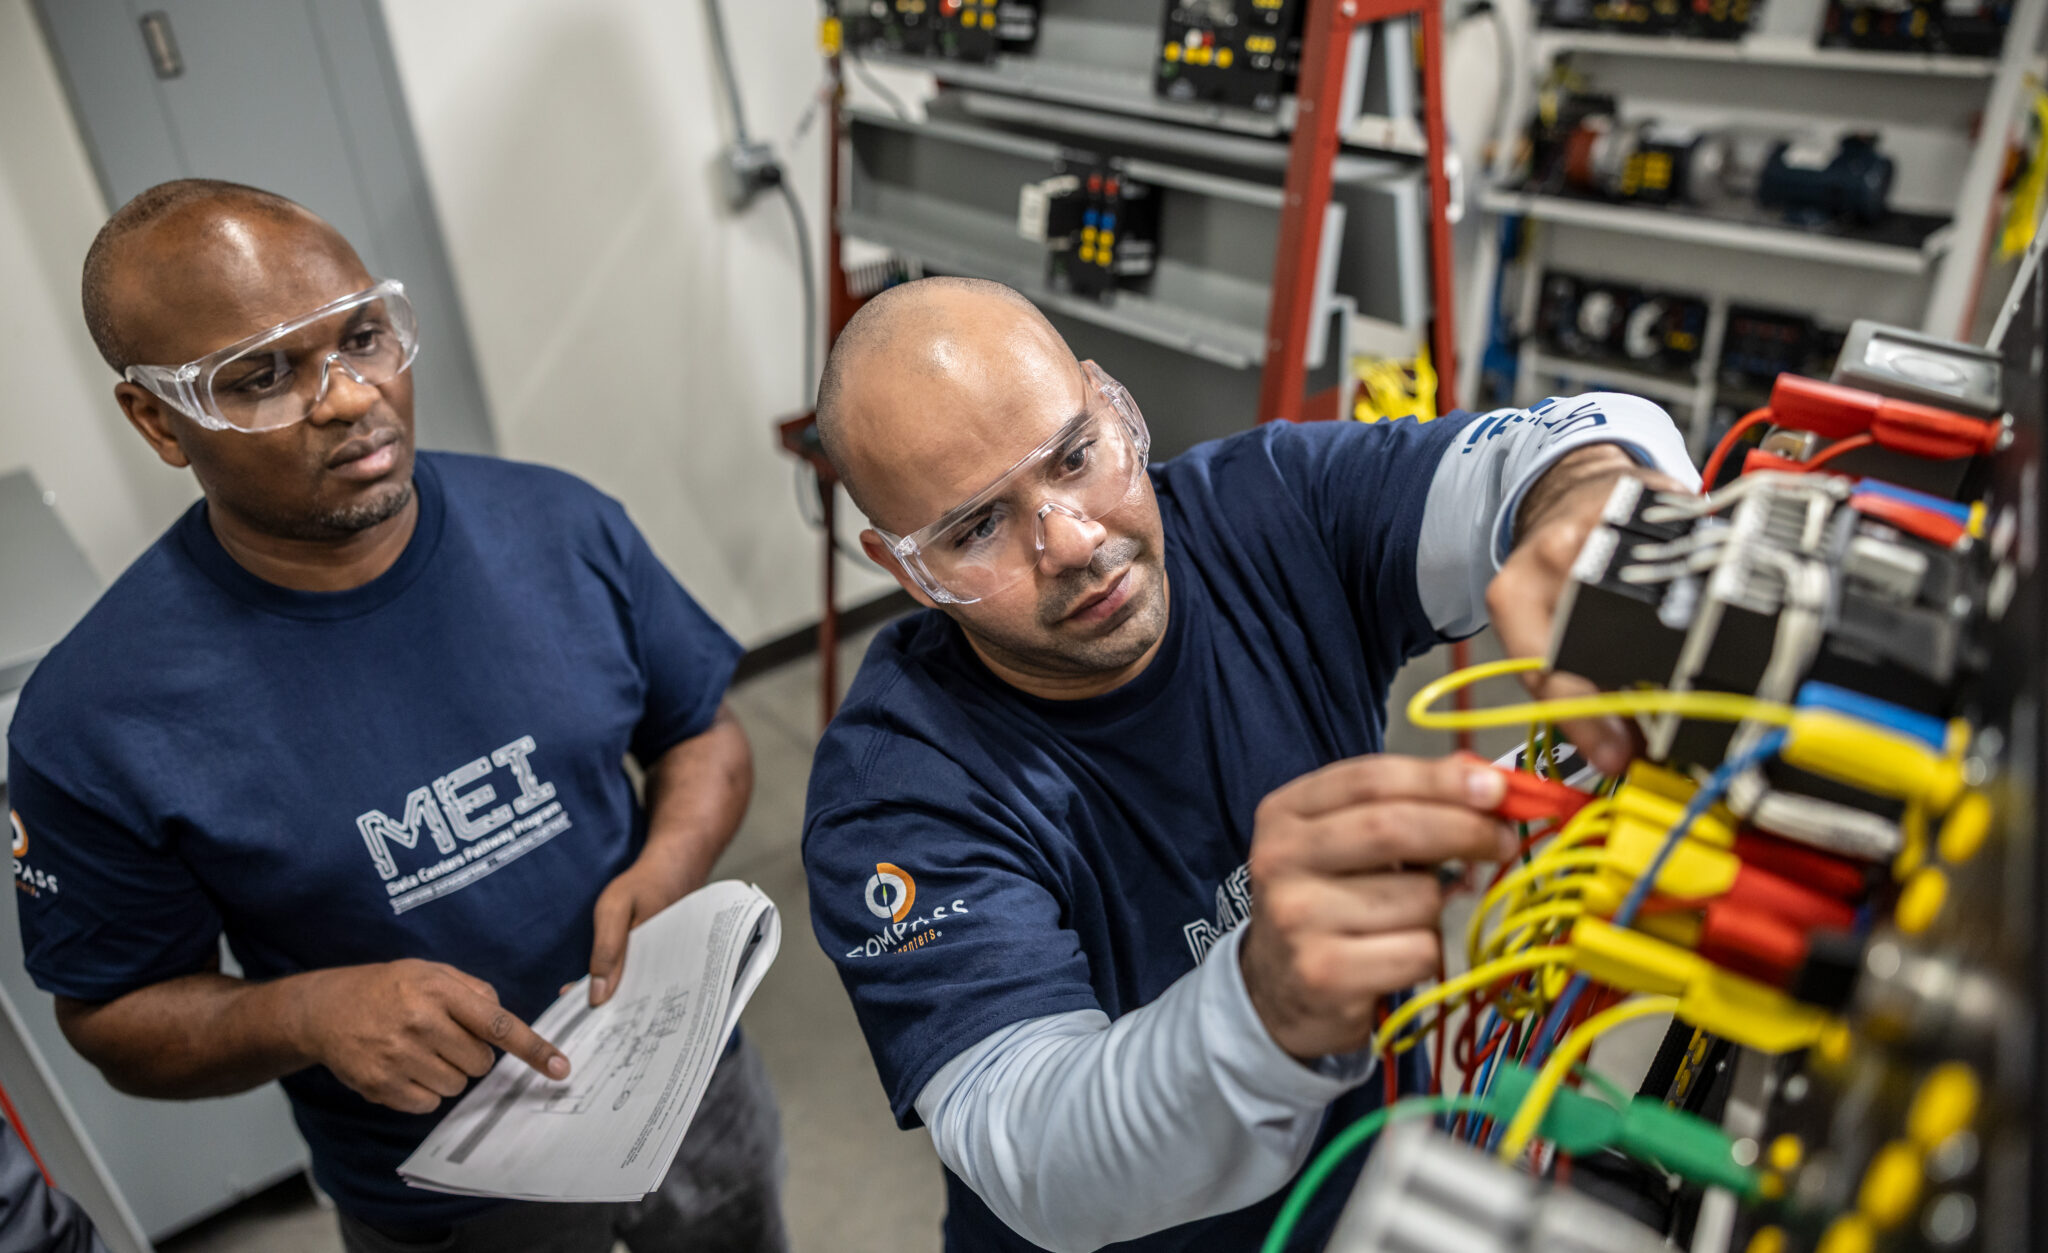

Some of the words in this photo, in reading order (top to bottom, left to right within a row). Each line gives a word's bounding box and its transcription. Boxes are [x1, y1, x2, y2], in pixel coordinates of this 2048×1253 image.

[356, 734, 557, 880] MEI
[385, 874, 419, 896] Data
[417, 854, 466, 882] Centers
[463, 827, 516, 862] Pathway
[511, 801, 562, 834] Program
[13, 859, 58, 894] PASS
